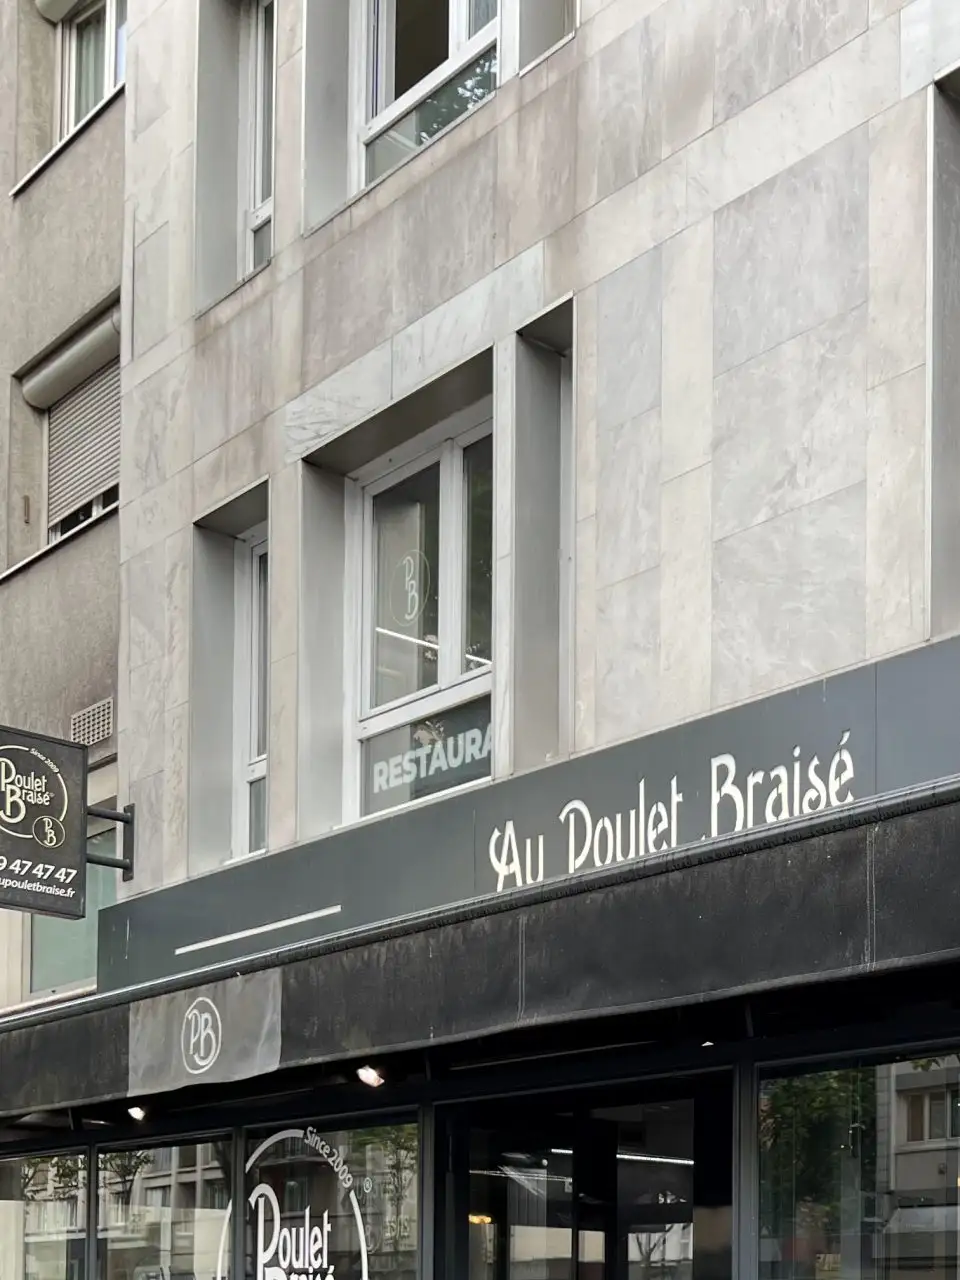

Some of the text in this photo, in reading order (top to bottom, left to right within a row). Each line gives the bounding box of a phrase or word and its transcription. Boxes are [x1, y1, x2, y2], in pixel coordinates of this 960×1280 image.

[402, 556, 419, 621] PB
[0, 757, 47, 792] Poulet
[373, 722, 492, 794] RESTAURA
[43, 817, 57, 846] PB
[489, 730, 854, 892] Au Poulet Braisé
[9, 859, 32, 876] 47
[32, 863, 55, 880] 47
[55, 867, 77, 884] 47
[186, 1003, 216, 1065] PB
[304, 1126, 353, 1188] Since 2009
